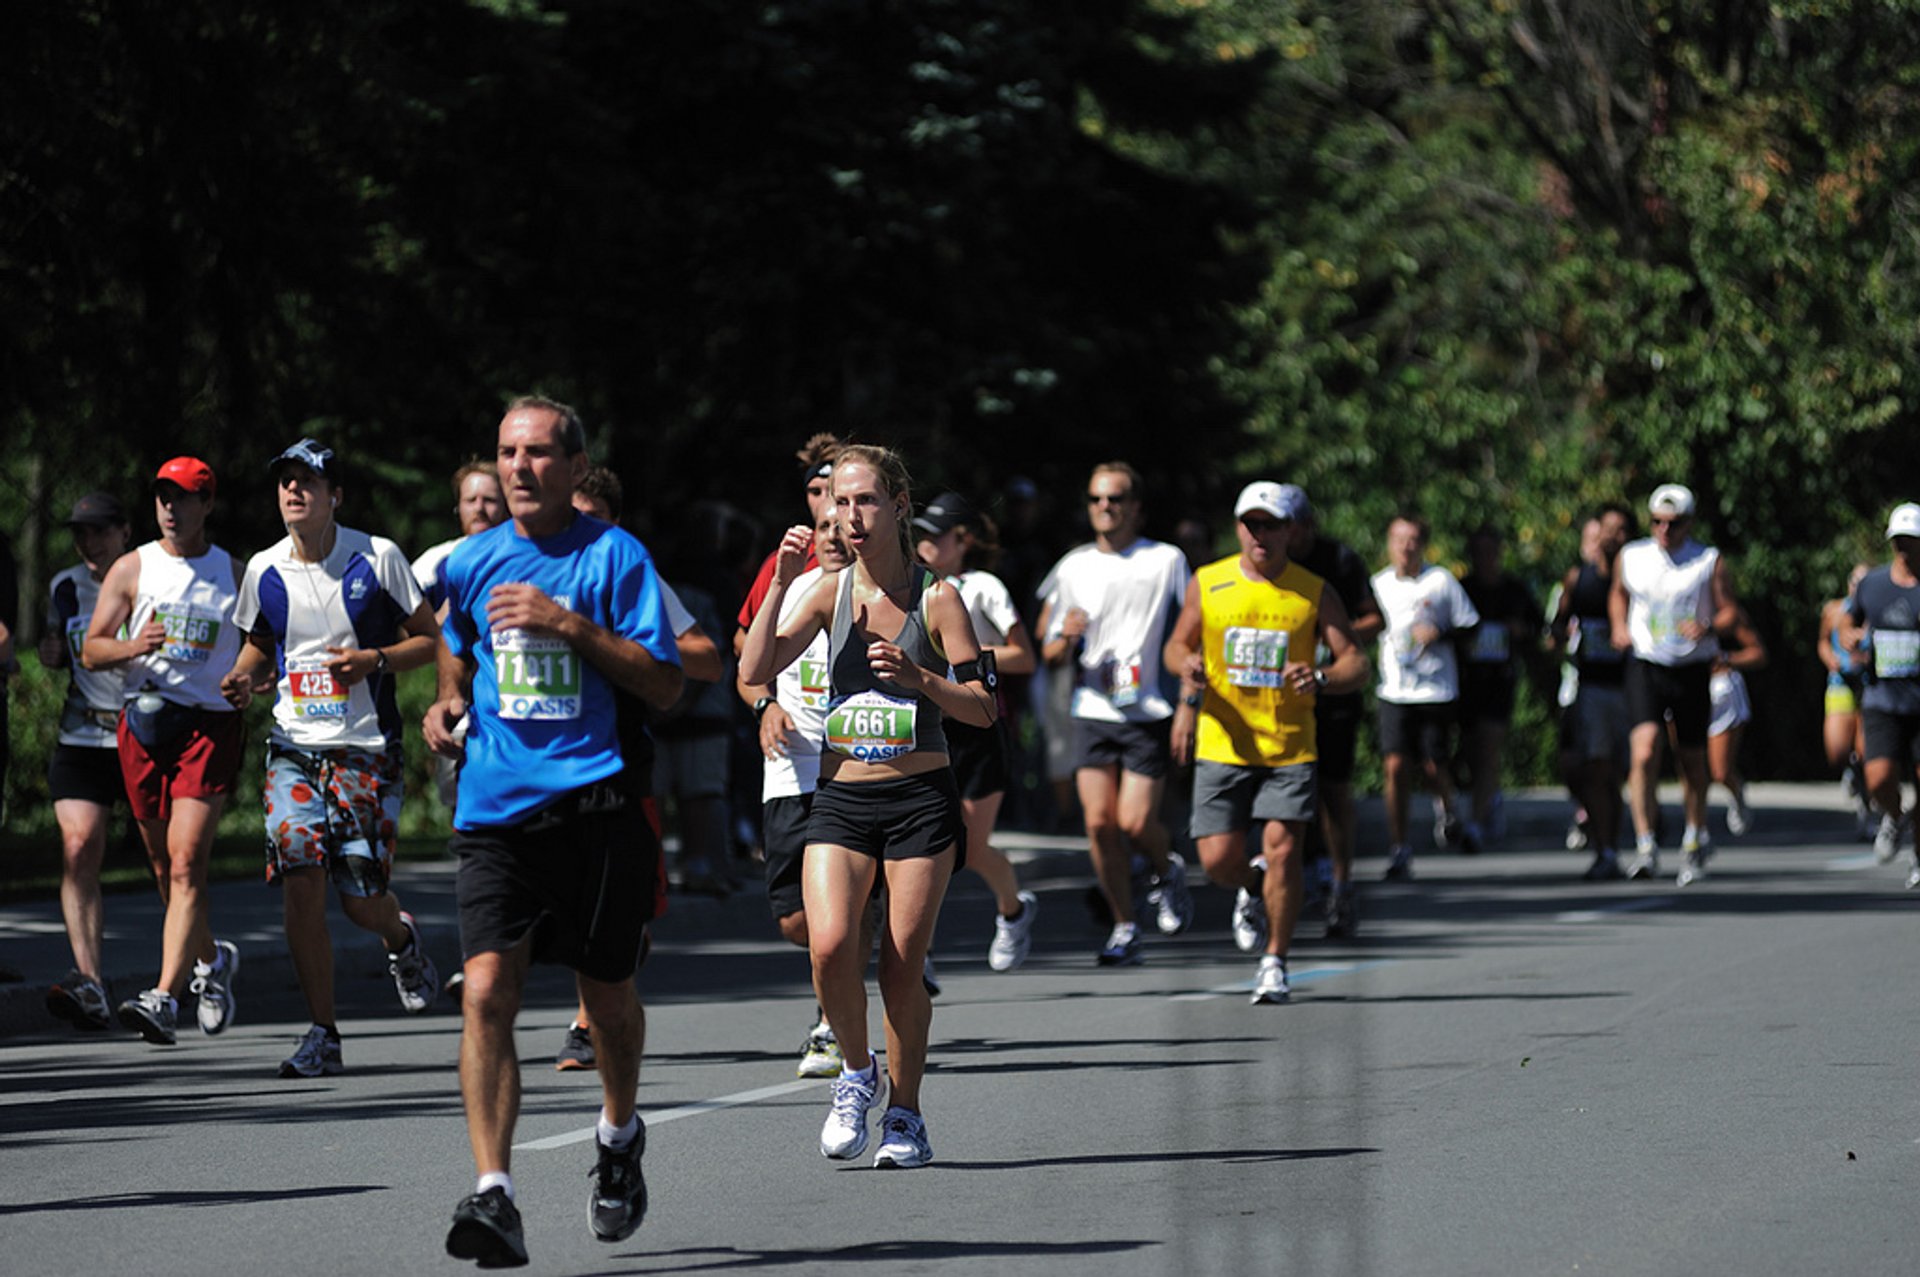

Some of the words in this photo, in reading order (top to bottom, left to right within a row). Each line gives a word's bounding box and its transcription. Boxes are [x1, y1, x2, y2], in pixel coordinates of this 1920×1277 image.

[300, 673, 333, 696] 425
[306, 702, 349, 716] OASIS
[512, 697, 576, 717] OASIS
[839, 708, 896, 736] 7661
